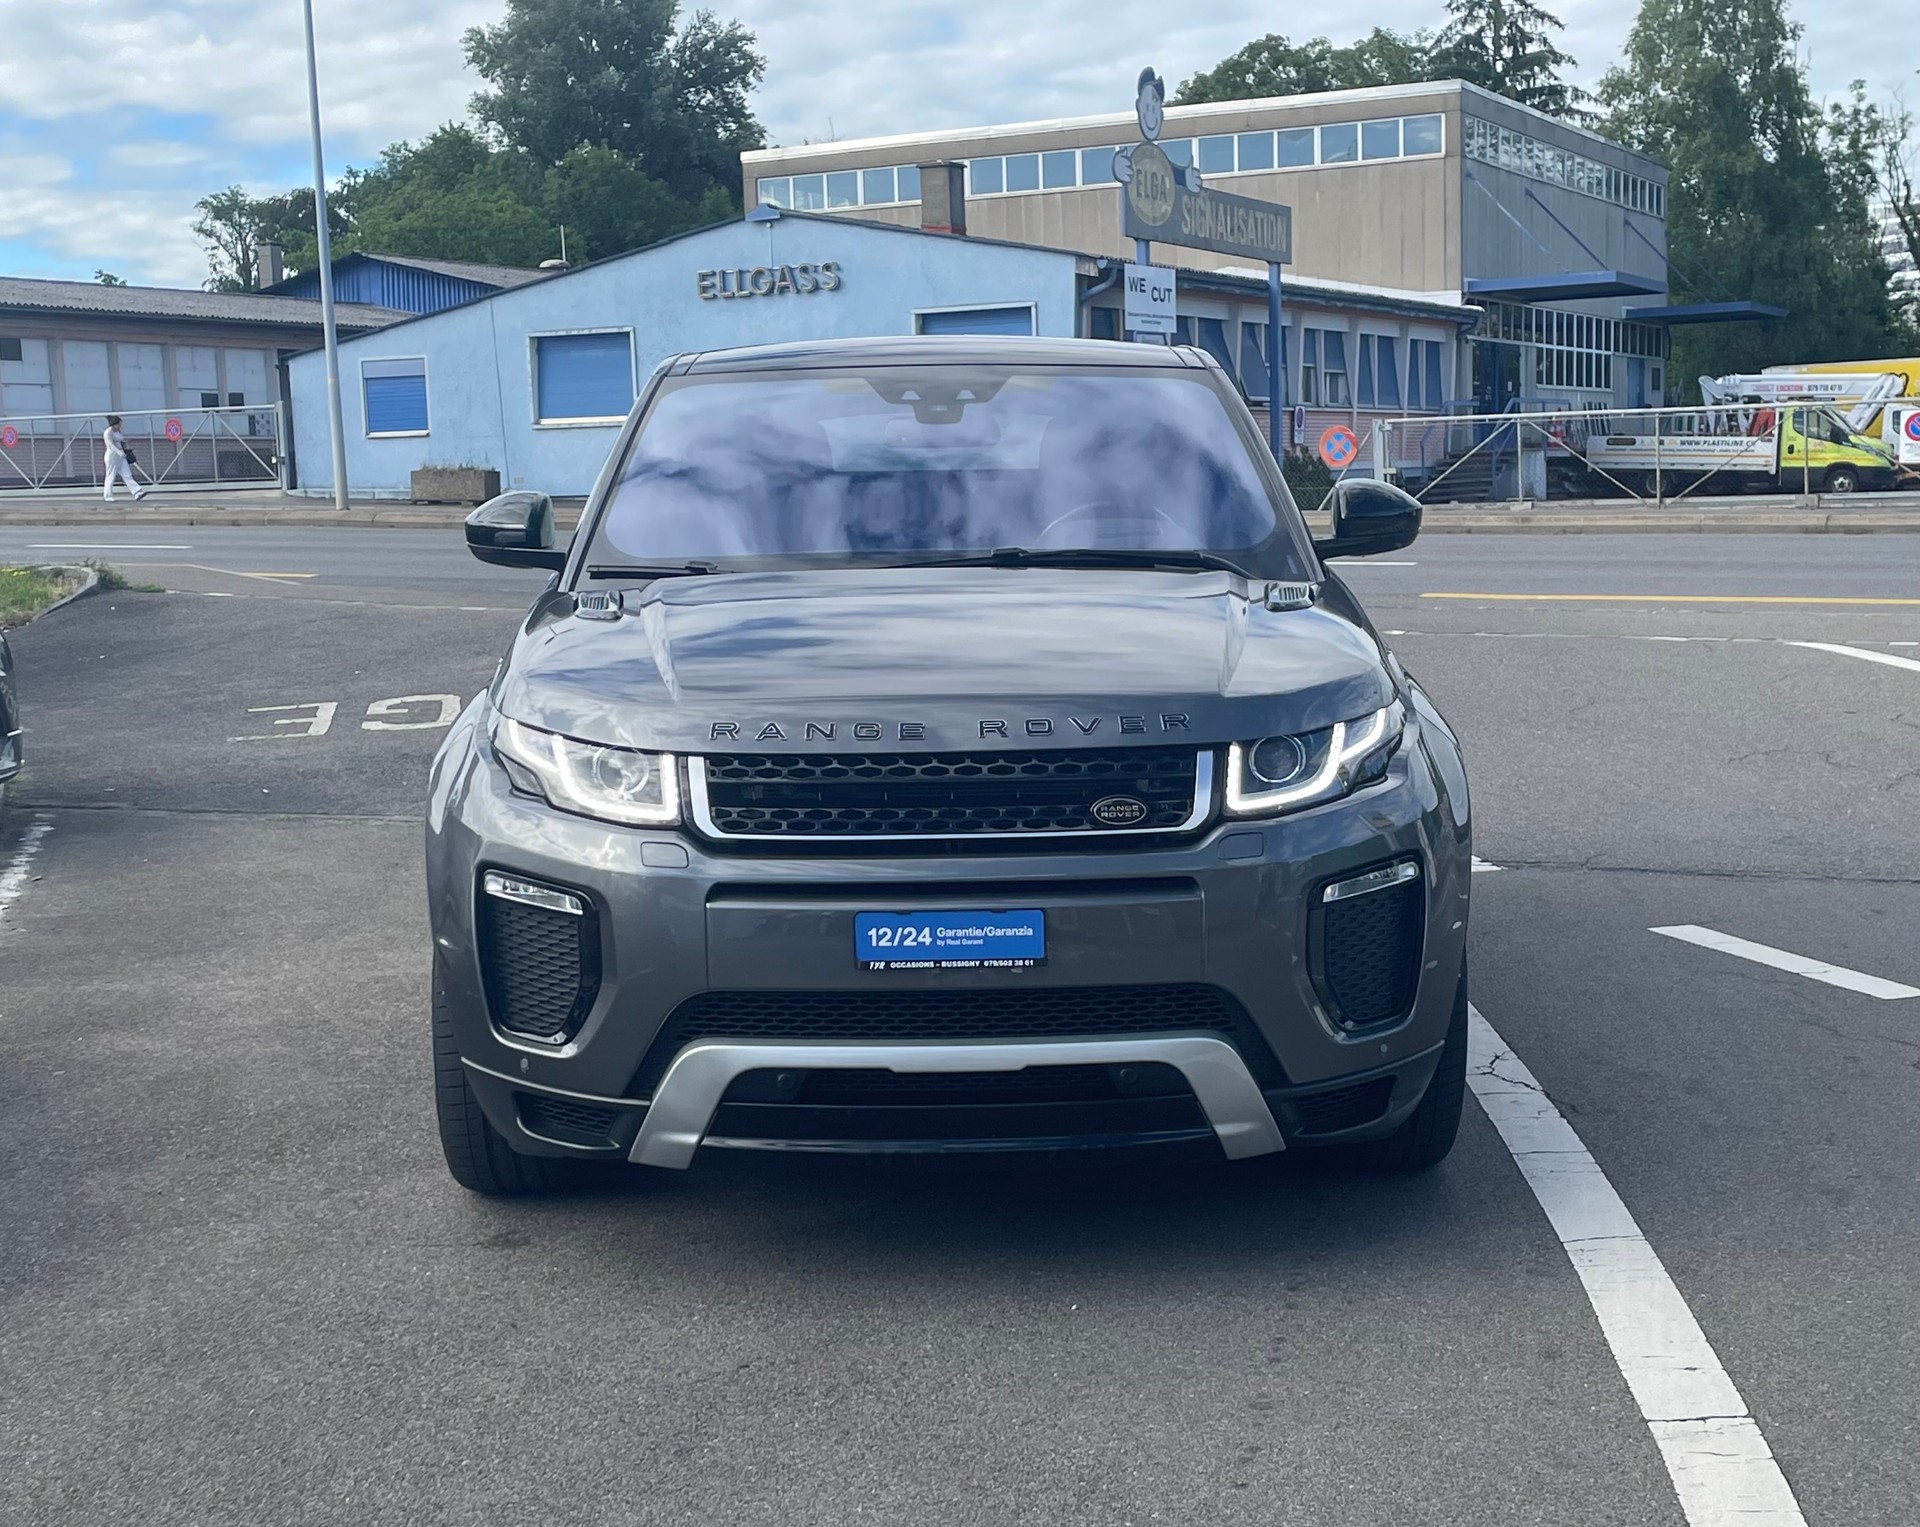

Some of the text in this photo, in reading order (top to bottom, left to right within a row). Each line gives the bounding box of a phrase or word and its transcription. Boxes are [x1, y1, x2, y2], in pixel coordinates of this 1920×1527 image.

[1136, 168, 1168, 202] ELGA
[1181, 193, 1287, 253] SIGNALISATION
[697, 261, 841, 299] ELLGASS
[1128, 276, 1173, 303] WE CUT
[708, 713, 1193, 741] RANGE ROVER
[867, 926, 933, 947] 12/24
[936, 925, 1034, 938] Garantie/Garanzia
[962, 938, 984, 946] Garant
[890, 961, 935, 969] OCCASIONS
[941, 960, 981, 968] BUSSIGNY
